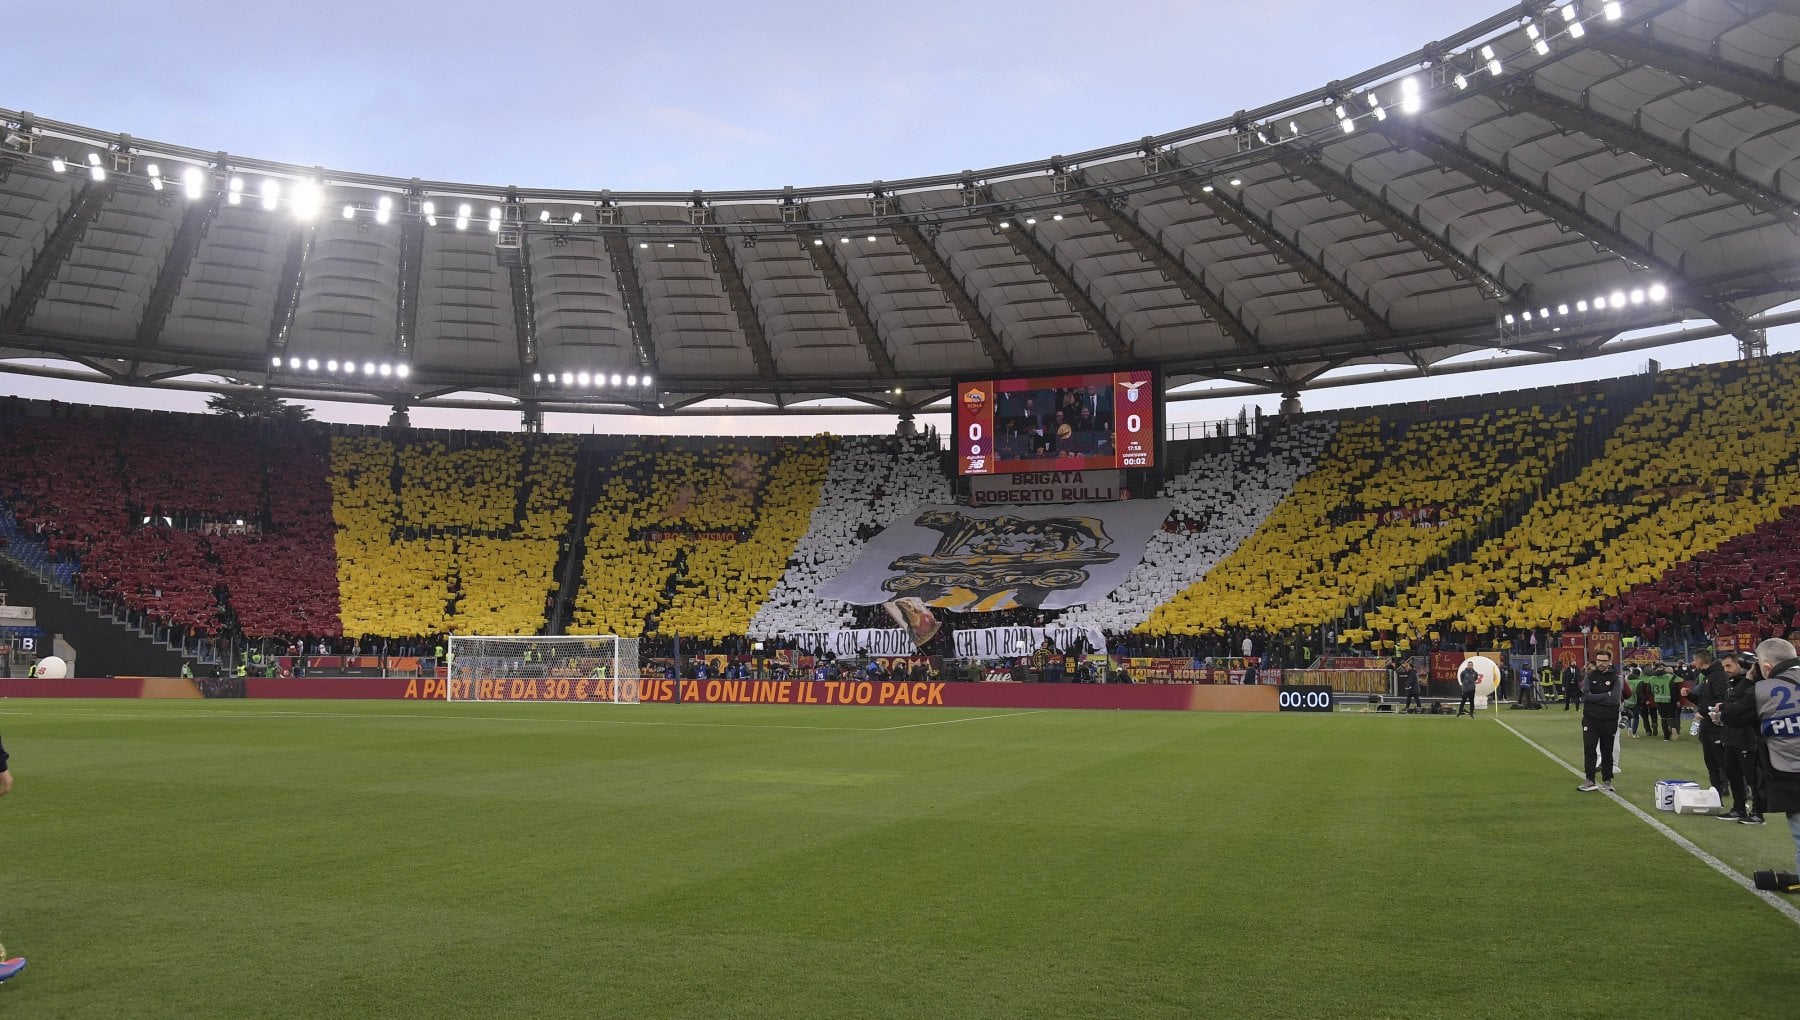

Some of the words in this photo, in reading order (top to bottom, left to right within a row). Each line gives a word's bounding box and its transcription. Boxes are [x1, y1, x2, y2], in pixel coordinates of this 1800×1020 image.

[969, 423, 982, 441] 0
[1127, 414, 1141, 433] 0
[1011, 472, 1084, 485] BRIGATA
[975, 488, 1054, 503] ROBERTO
[1061, 487, 1112, 500] RULLI
[22, 637, 34, 650] B
[836, 630, 859, 656] CON
[957, 630, 979, 657] CHI
[985, 630, 998, 655] DI
[1003, 628, 1036, 655] ROMA
[404, 679, 418, 698] A
[422, 679, 506, 699] PARTIRE
[510, 679, 538, 699] DA
[542, 679, 571, 700] 30
[575, 680, 589, 700] €
[593, 680, 699, 702] ACQUISTA
[706, 680, 792, 703] ONLINE
[797, 681, 818, 703] IL
[824, 681, 873, 704] TUO
[879, 682, 946, 705] PACK
[1654, 684, 1665, 694] 31
[1279, 691, 1330, 708] 00:00
